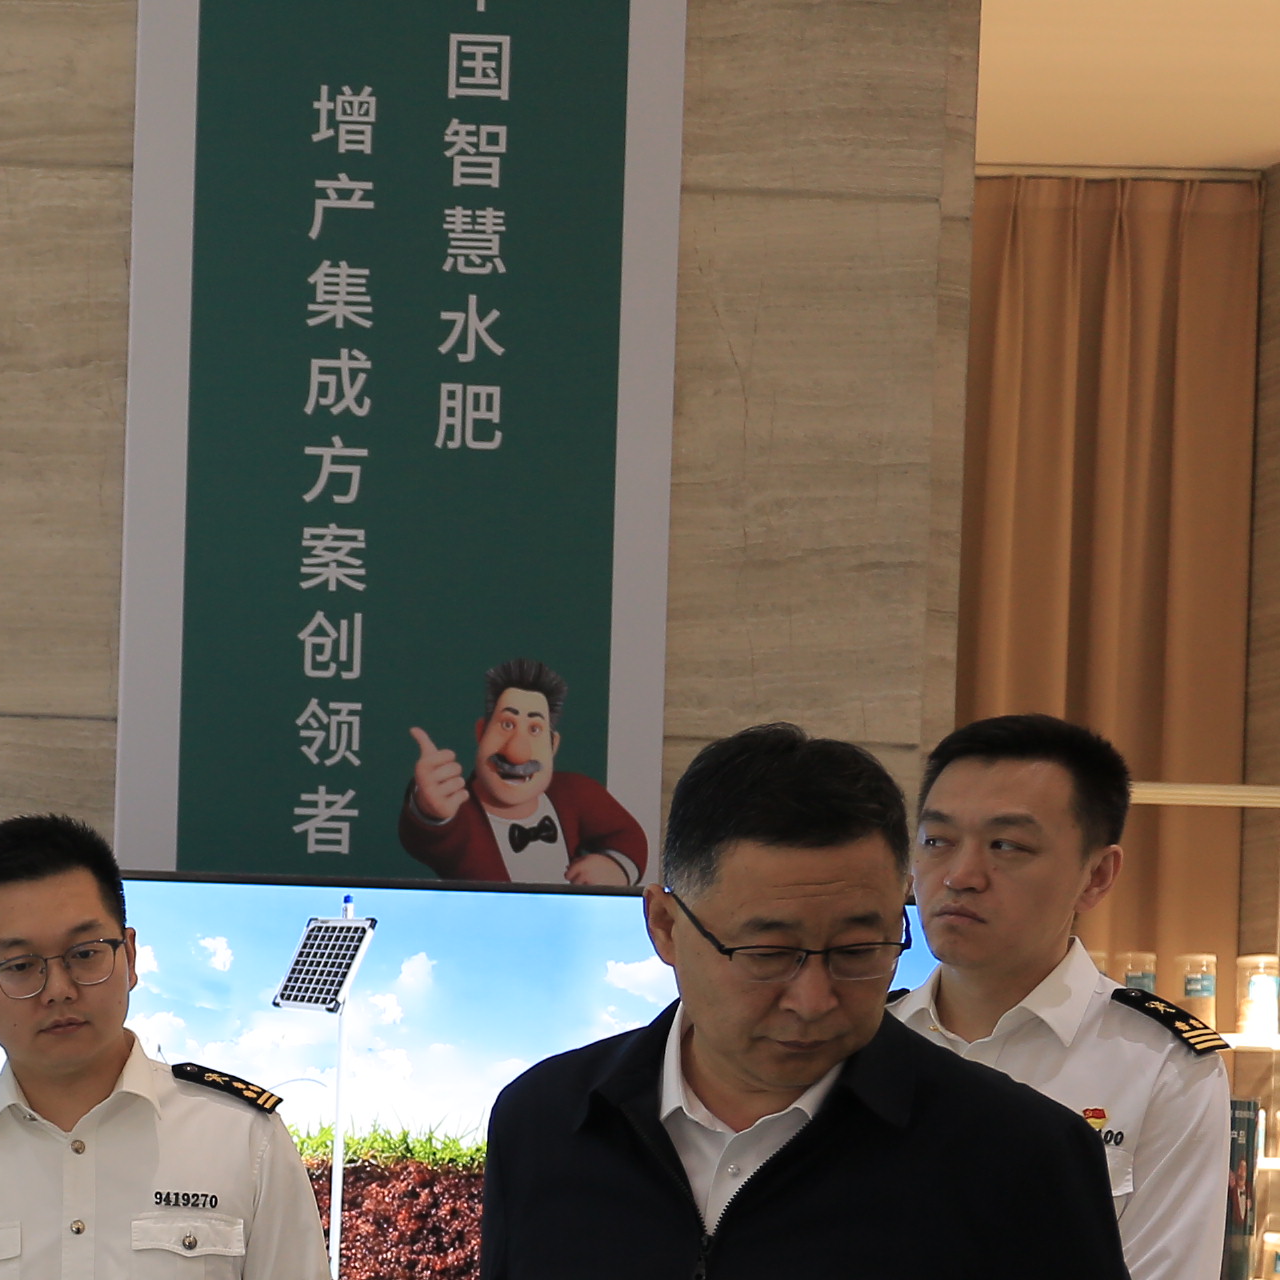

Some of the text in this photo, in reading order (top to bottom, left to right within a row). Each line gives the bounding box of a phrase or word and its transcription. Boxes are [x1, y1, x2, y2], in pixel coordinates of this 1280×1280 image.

[435, 0, 510, 450] 国智慧水肥
[292, 84, 377, 857] 增产集成方案创领者
[154, 1191, 218, 1208] 9419270
